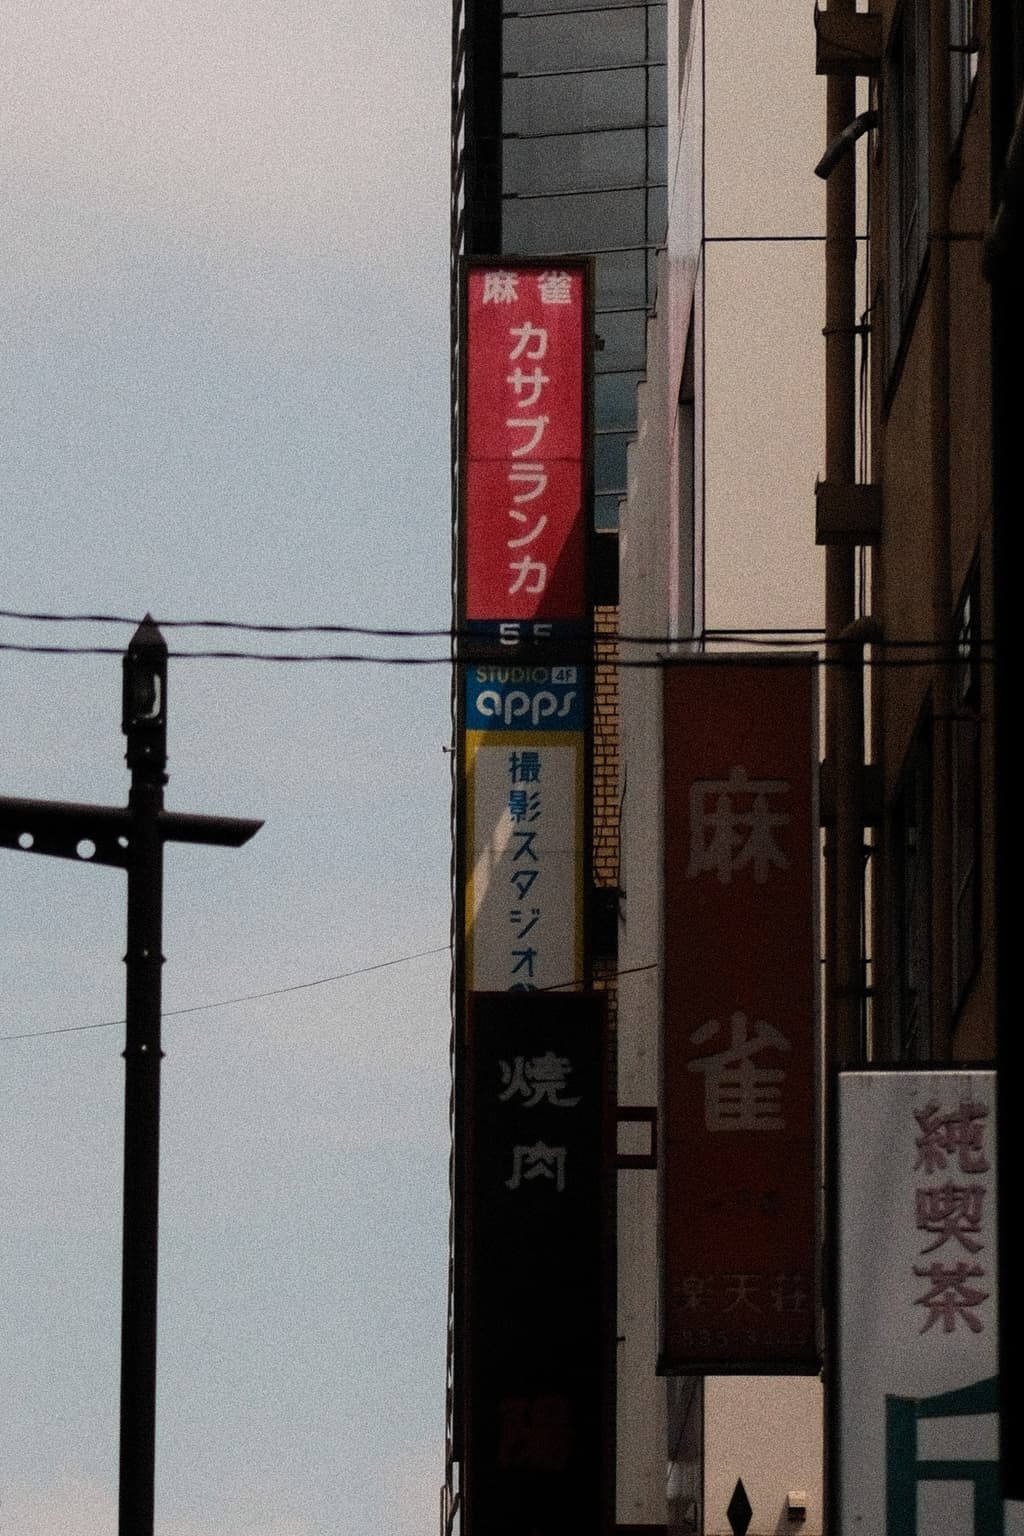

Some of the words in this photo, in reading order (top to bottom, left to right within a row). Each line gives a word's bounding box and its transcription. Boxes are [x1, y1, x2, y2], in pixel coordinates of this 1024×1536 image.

[482, 269, 573, 305] 麻雀
[506, 321, 550, 595] カサブランカ
[475, 690, 577, 725] apps
[476, 666, 548, 683] STUDIO
[507, 751, 543, 993] 撮影スタジオ
[687, 765, 794, 1133] 麻雀
[496, 1050, 584, 1193] 焼肉
[913, 1101, 990, 1335] 純喫茶
